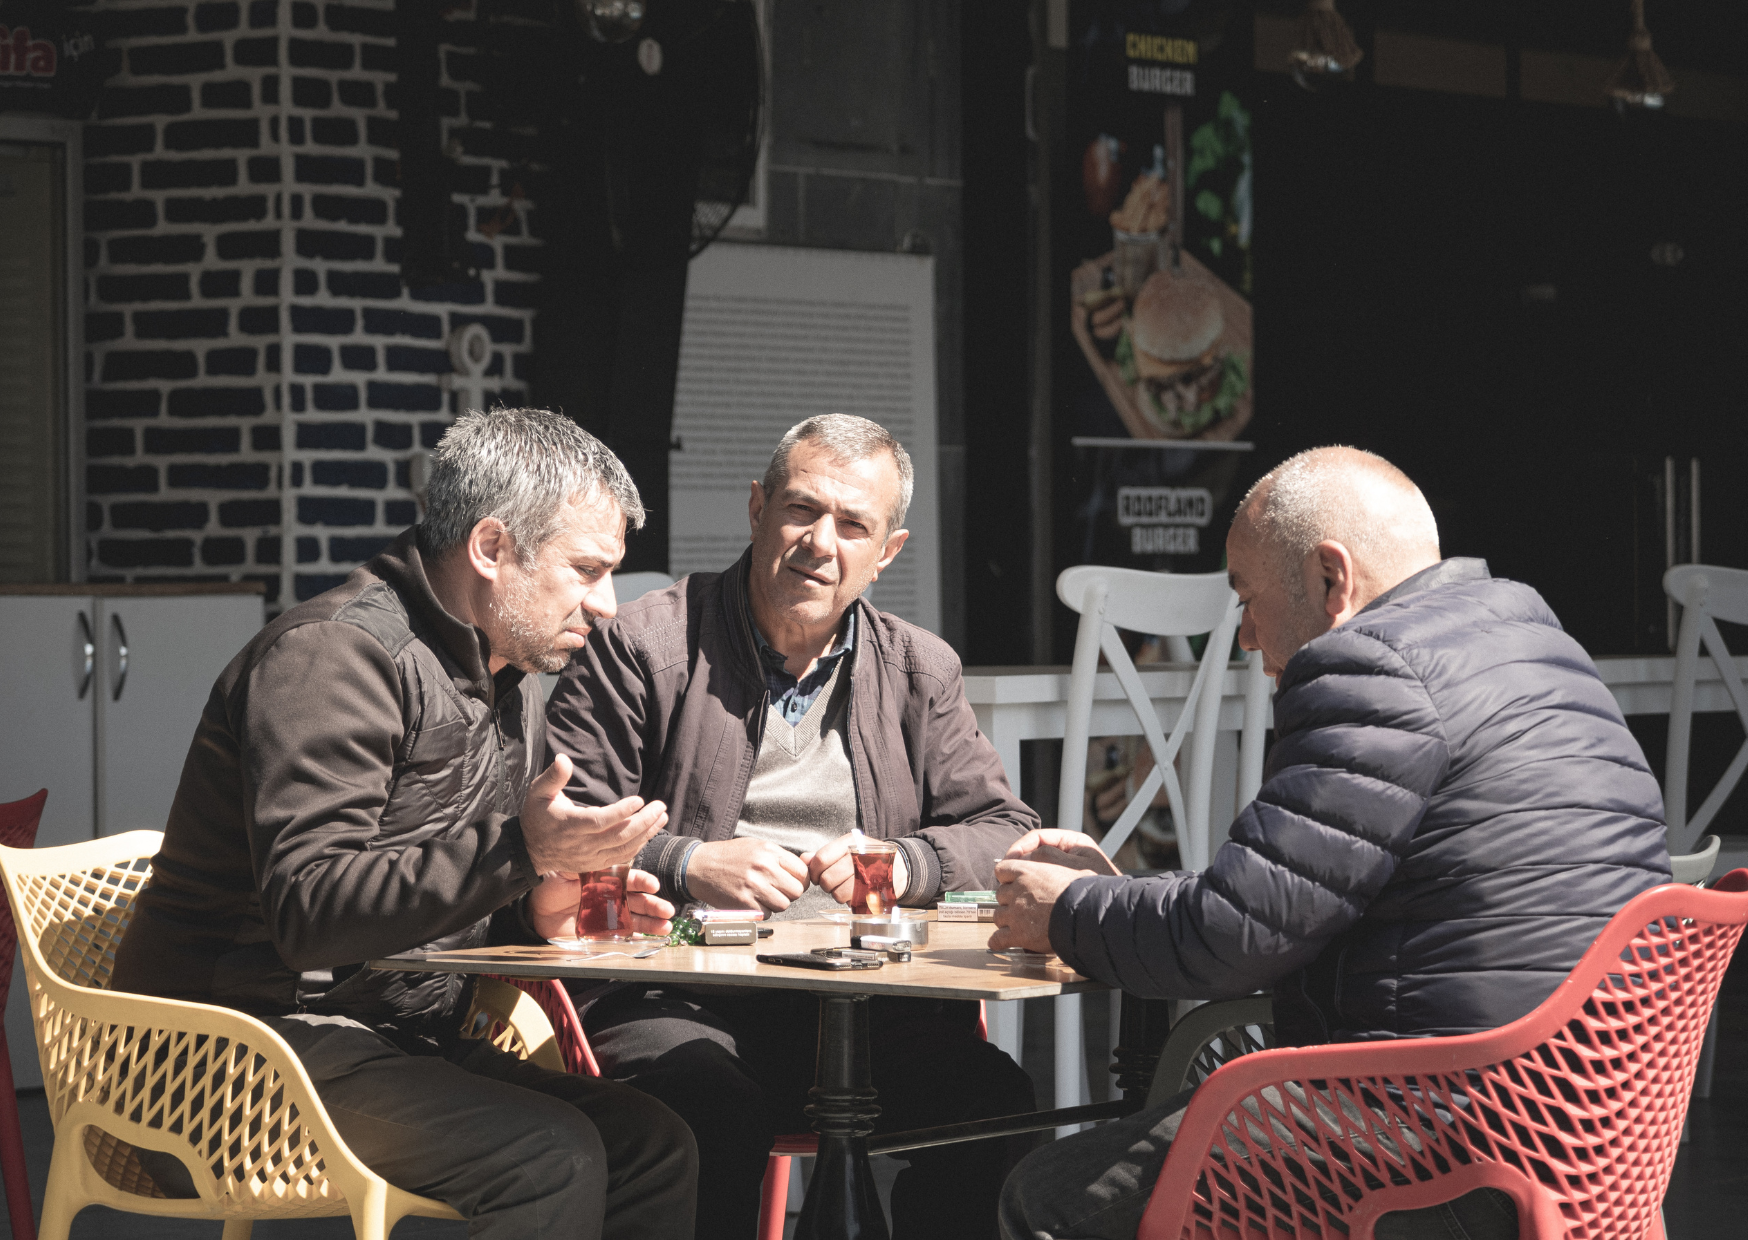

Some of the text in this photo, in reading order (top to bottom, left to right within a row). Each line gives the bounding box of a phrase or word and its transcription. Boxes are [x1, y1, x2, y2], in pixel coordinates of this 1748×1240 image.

[1126, 32, 1198, 65] CHICKEN
[1128, 65, 1195, 96] BURGER
[1121, 493, 1207, 519] ROOFLAND
[1131, 527, 1199, 554] BURGER
